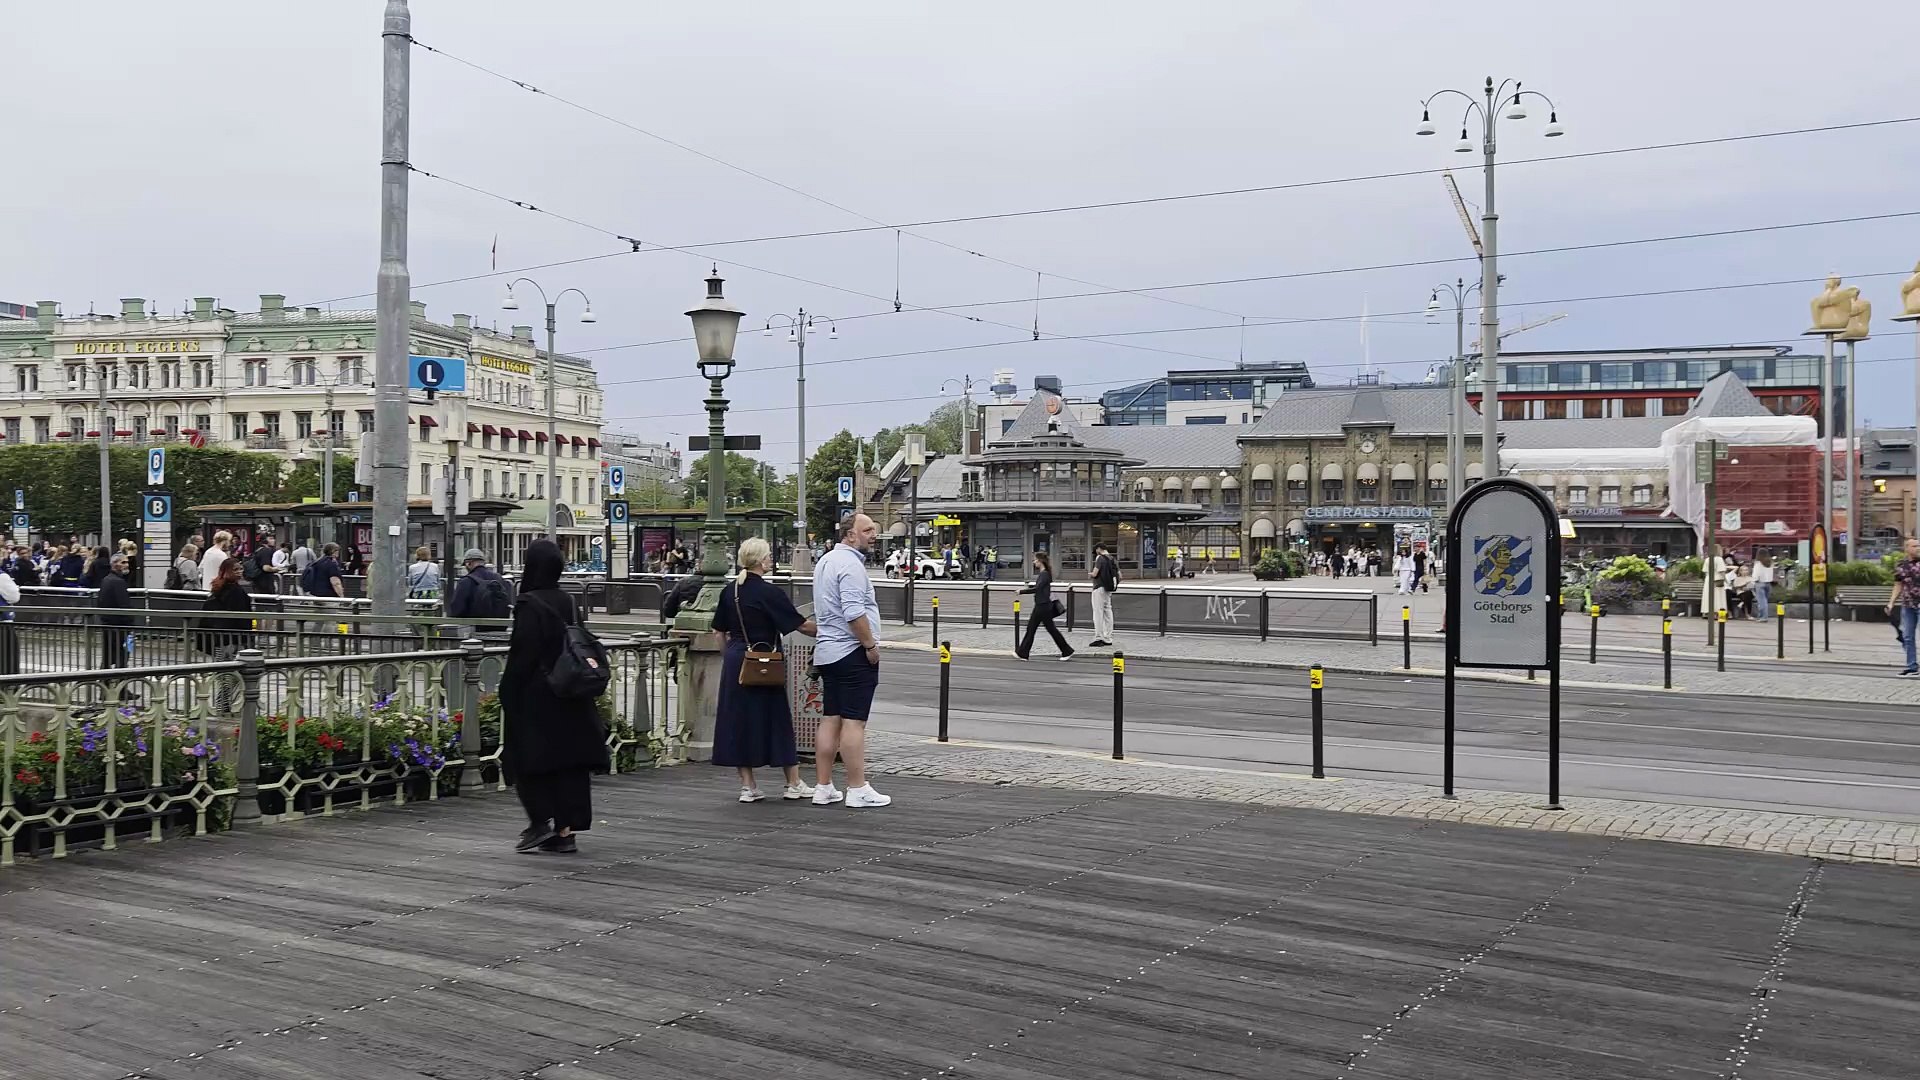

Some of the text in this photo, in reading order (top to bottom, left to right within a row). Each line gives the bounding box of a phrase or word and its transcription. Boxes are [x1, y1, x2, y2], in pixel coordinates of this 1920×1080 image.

[74, 341, 200, 354] HOTEL EGGERS
[481, 356, 531, 375] HOTEL EGGERS
[426, 364, 438, 383] L
[153, 454, 161, 469] B
[613, 470, 620, 482] C
[152, 500, 163, 514] B
[615, 506, 623, 518] C
[1304, 506, 1432, 518] CENTRALSTATION
[17, 516, 25, 525] C
[1473, 601, 1533, 614] Göteborgs
[1490, 614, 1515, 624] Stad
